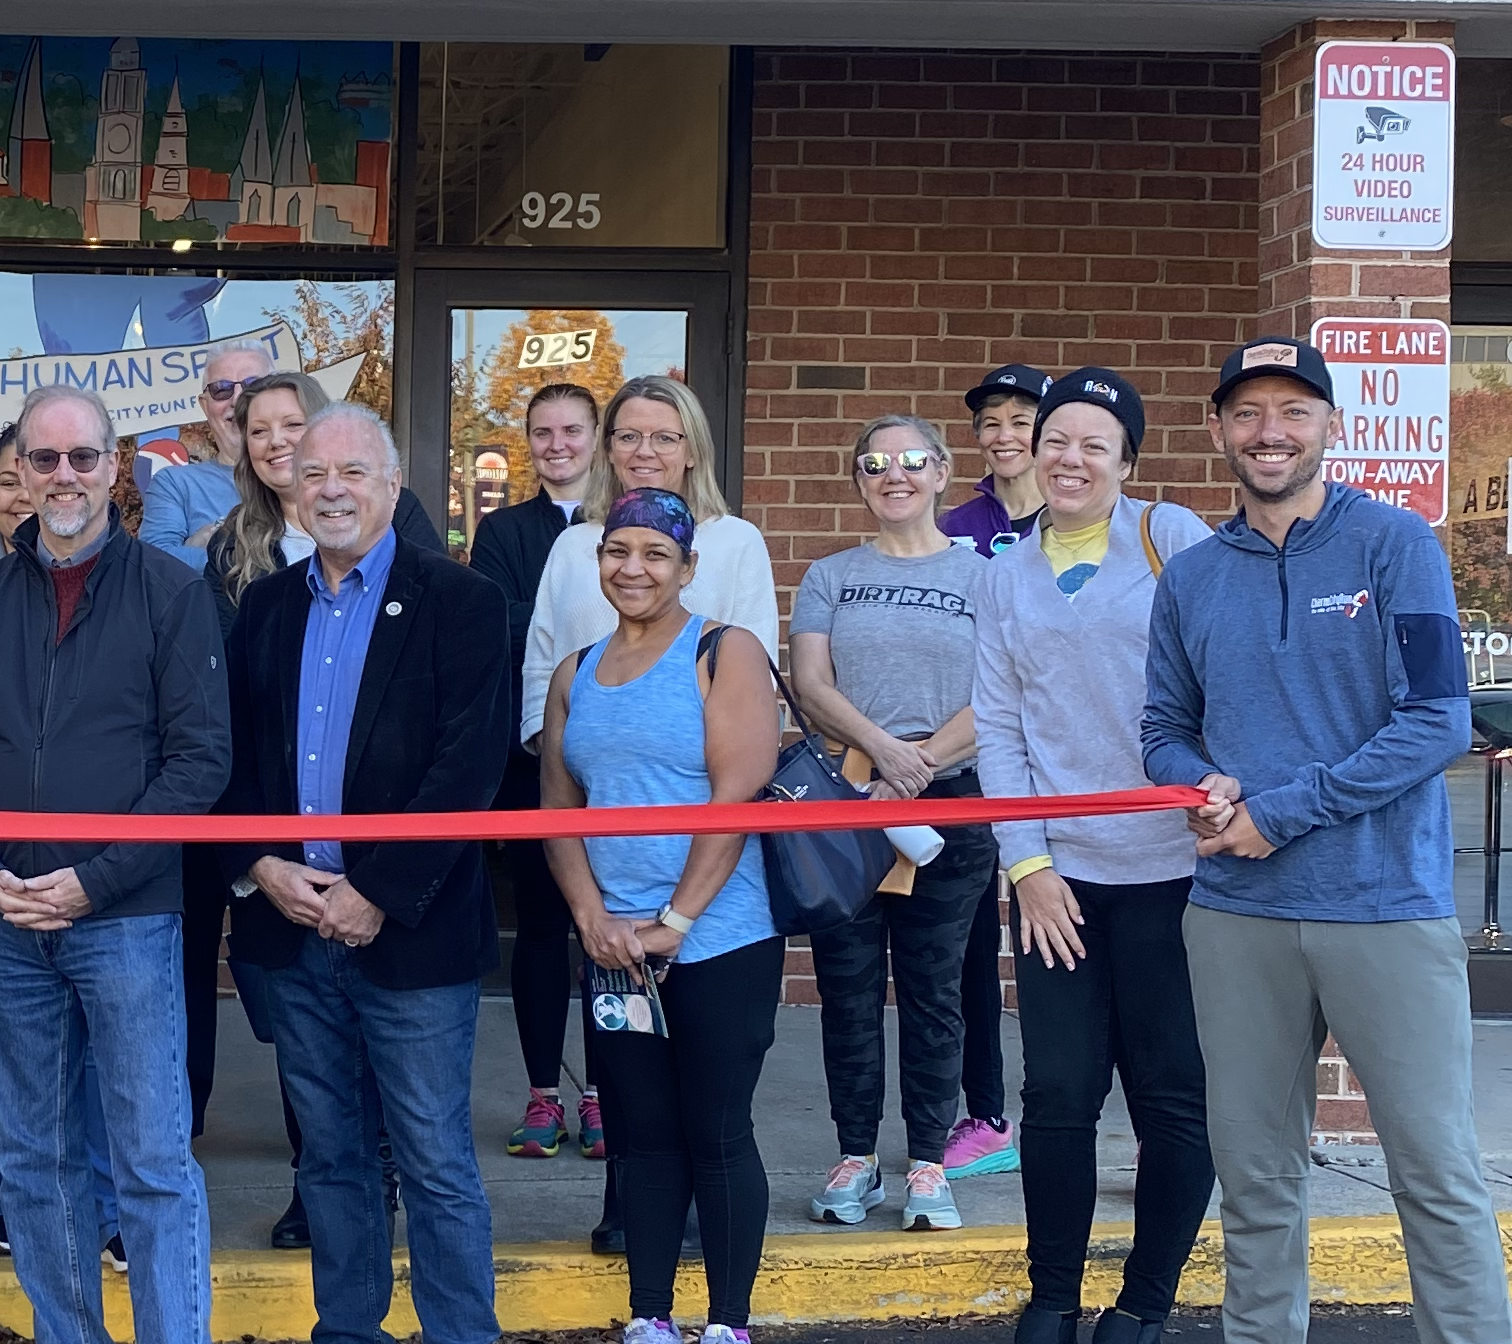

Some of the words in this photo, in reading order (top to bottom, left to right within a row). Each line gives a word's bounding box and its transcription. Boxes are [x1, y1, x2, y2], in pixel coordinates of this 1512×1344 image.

[1326, 64, 1444, 98] NOTICE
[1341, 152, 1365, 172] 24
[1371, 153, 1425, 173] HOUR
[1353, 179, 1412, 199] VIDEO
[521, 191, 602, 230] 925
[1323, 206, 1442, 223] SURVEILLANCE
[524, 331, 593, 365] 925
[1321, 330, 1372, 354] FIRE
[1380, 331, 1441, 355] LANE
[0, 356, 152, 395] HUMAN
[1361, 369, 1399, 406] NO
[1332, 415, 1443, 452] ARKING
[1321, 460, 1440, 484] TOW-AWAY
[1462, 478, 1478, 513] A
